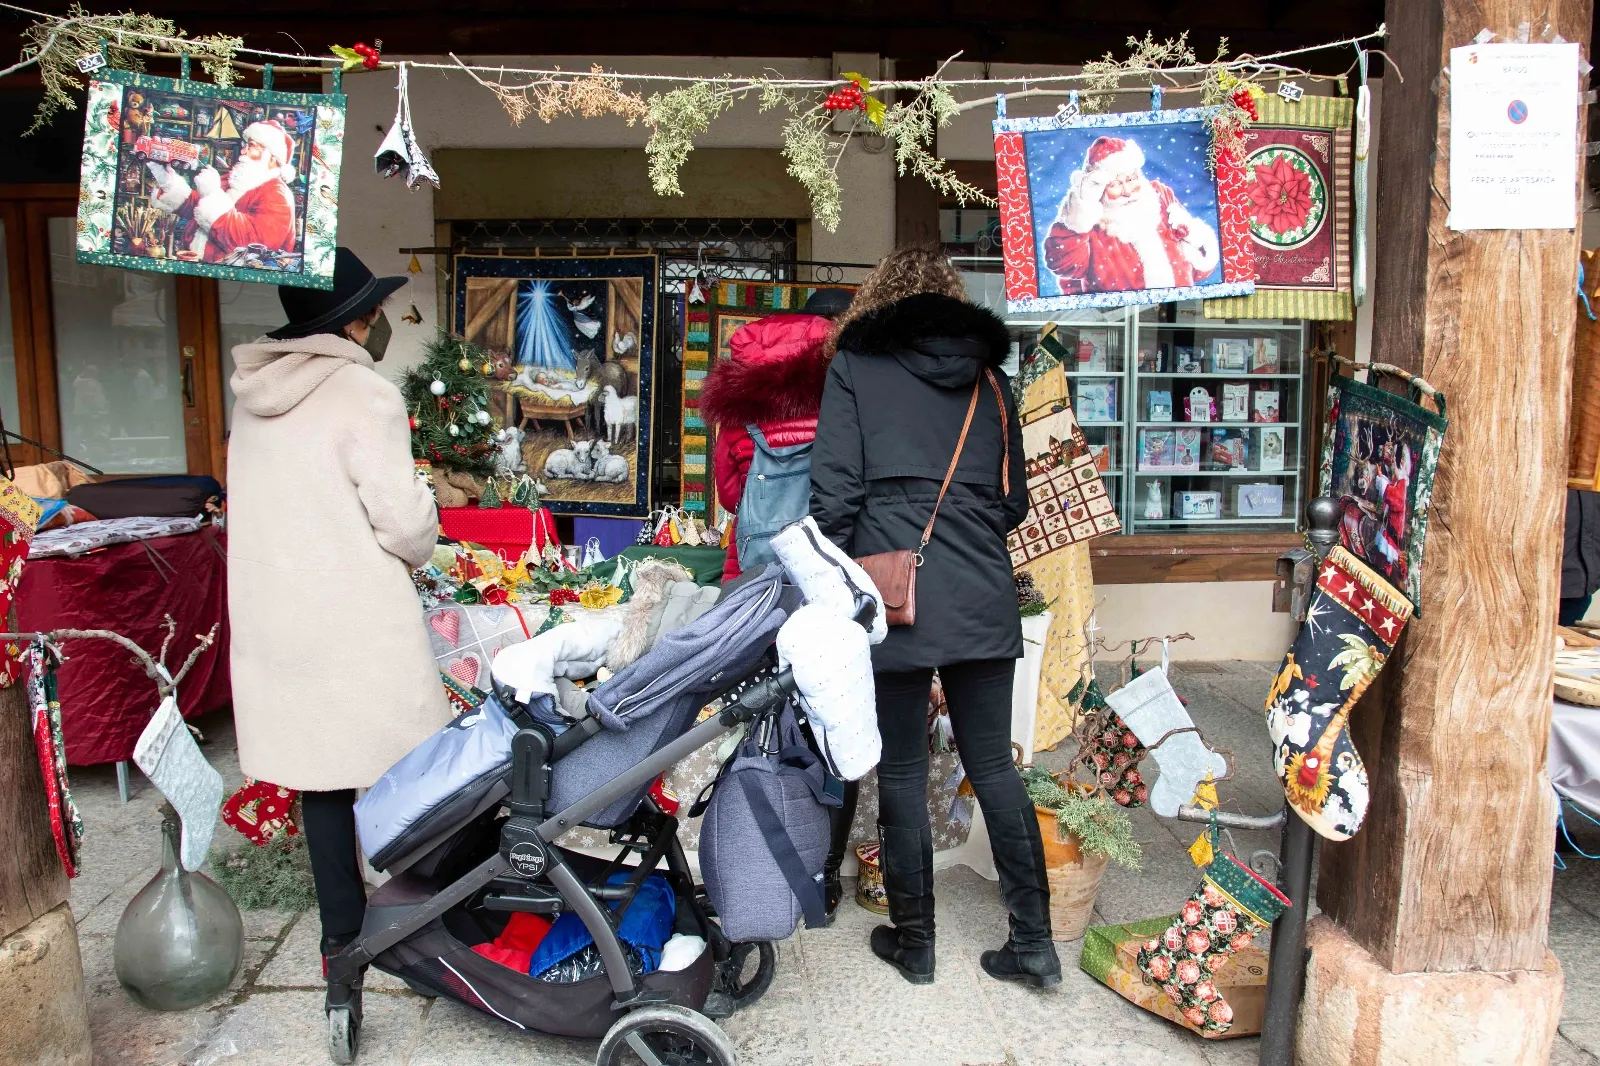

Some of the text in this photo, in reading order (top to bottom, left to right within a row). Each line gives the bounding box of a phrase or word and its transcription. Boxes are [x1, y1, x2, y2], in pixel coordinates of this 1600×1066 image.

[80, 56, 100, 69] 30€
[1059, 105, 1076, 122] 30€
[516, 862, 538, 871] YPSI
